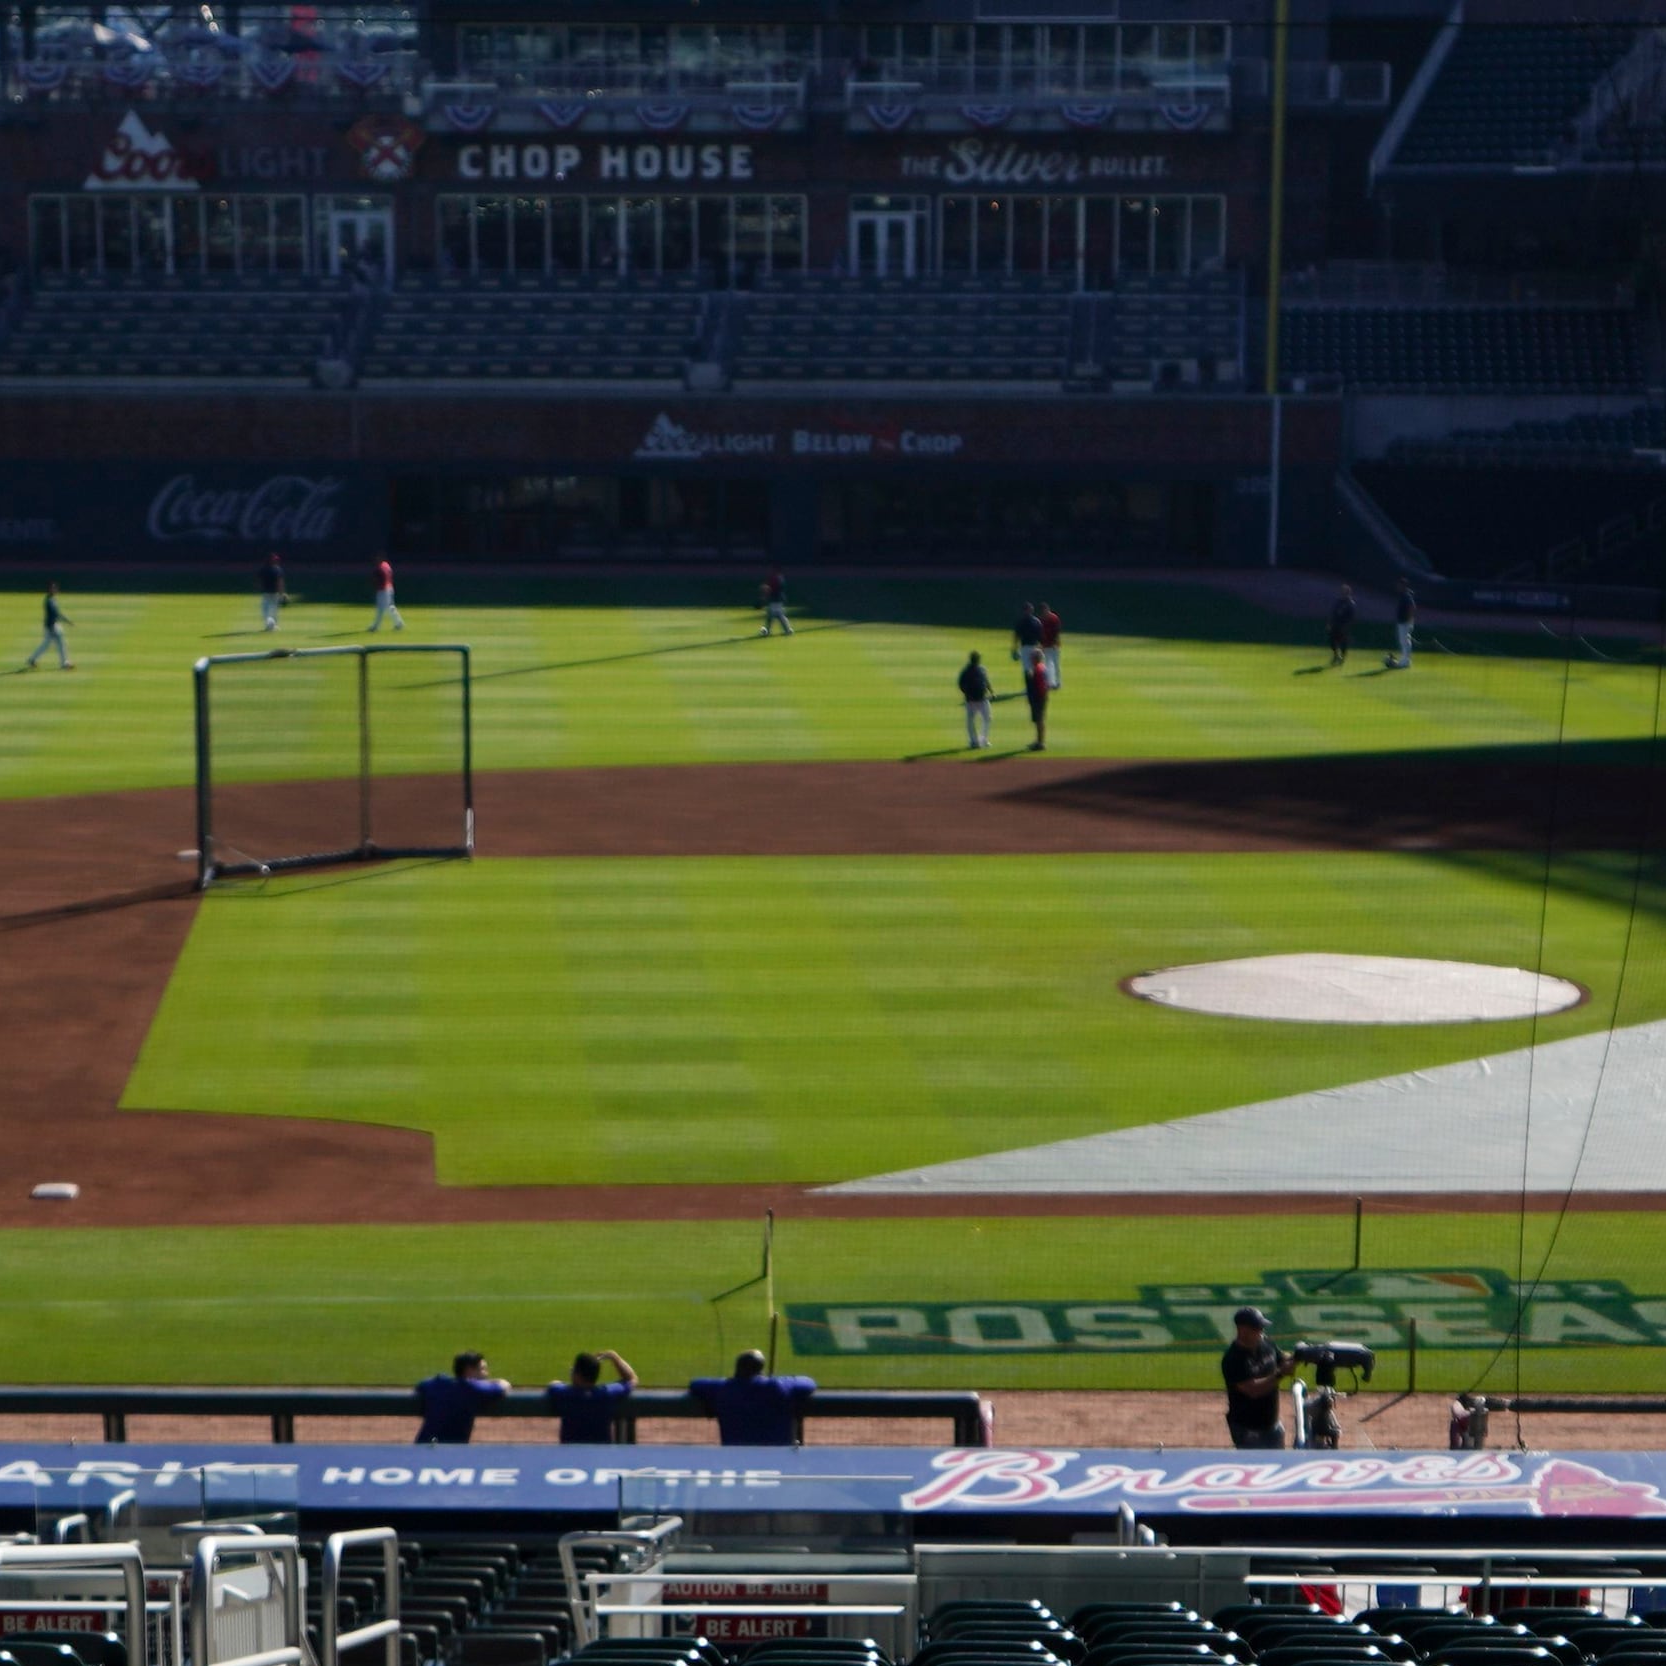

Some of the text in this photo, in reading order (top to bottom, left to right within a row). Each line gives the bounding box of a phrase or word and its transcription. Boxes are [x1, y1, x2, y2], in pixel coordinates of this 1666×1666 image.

[456, 143, 755, 180] CHOP HOUSE
[900, 155, 940, 177] THE
[944, 137, 1085, 184] Silver
[321, 1466, 521, 1487] HOME
[899, 1448, 1523, 1512] Braves
[2, 1614, 94, 1633] BE ALERT
[705, 1617, 797, 1638] BE ALERT
